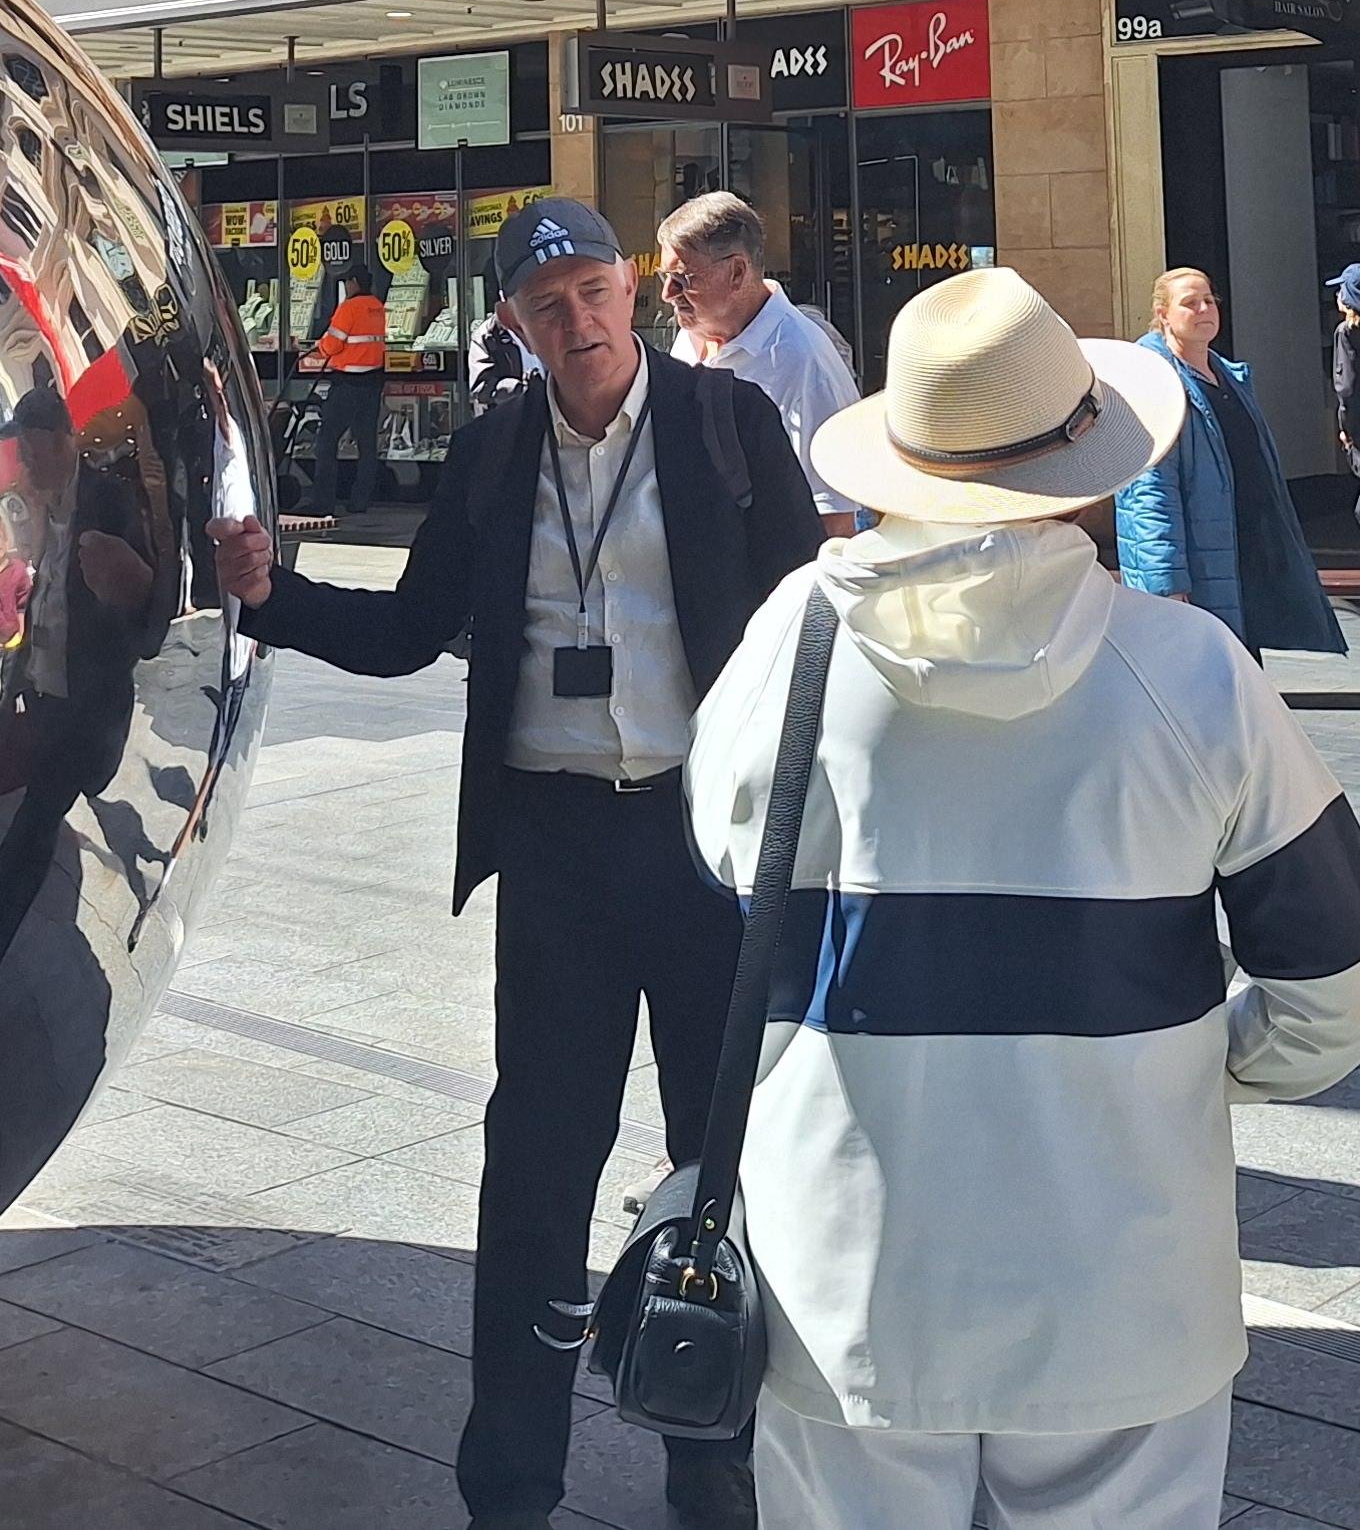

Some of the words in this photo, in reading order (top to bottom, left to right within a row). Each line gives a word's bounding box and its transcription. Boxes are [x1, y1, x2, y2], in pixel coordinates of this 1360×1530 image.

[1273, 1, 1296, 16] HAIR
[1296, 4, 1326, 18] SALON
[1117, 16, 1162, 40] 99a
[771, 44, 828, 78] ADES
[601, 61, 696, 102] SHADES
[438, 101, 486, 110] DIAMONDS
[166, 104, 265, 134] SHIELS
[558, 114, 583, 133] 101
[469, 211, 503, 228] AVINGS
[419, 236, 452, 258] SILVER
[530, 228, 569, 248] adidas
[324, 241, 350, 261] GOLD
[892, 242, 969, 270] SHADES
